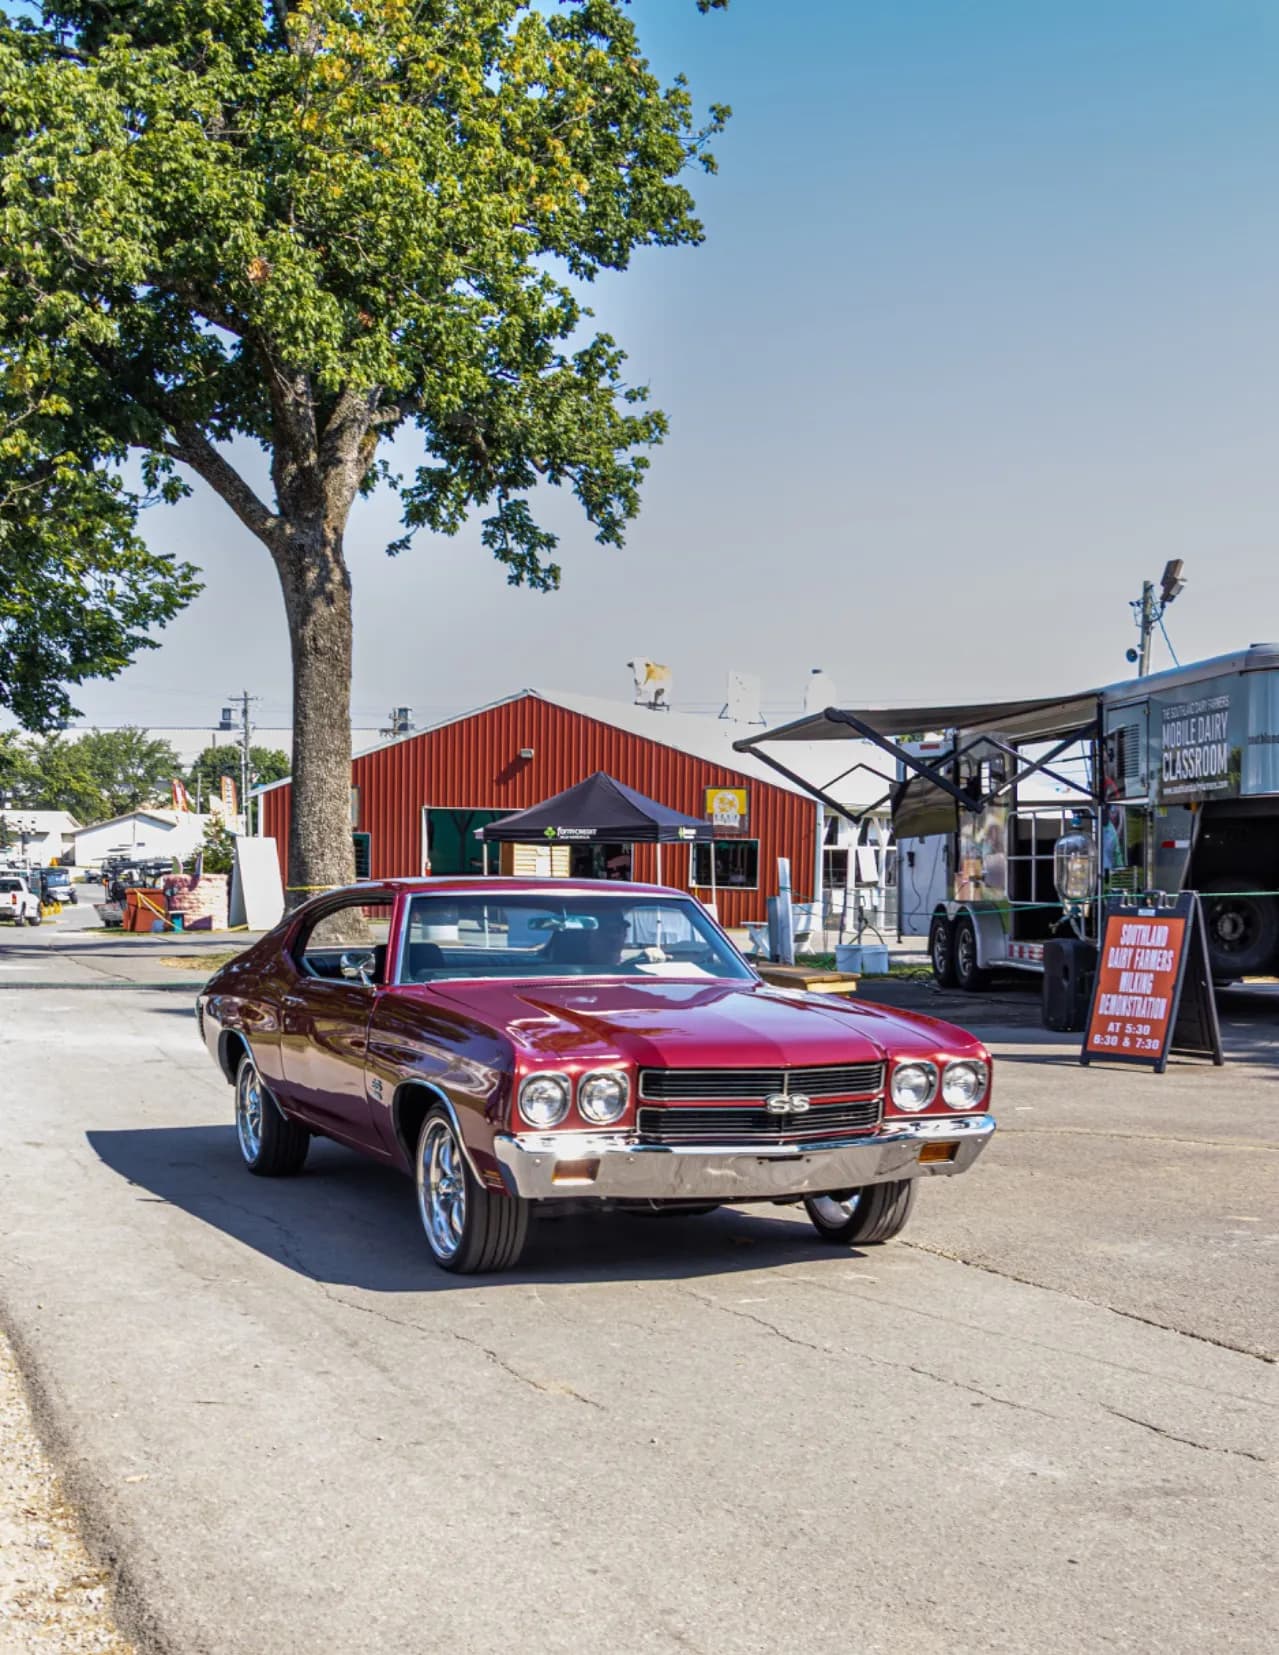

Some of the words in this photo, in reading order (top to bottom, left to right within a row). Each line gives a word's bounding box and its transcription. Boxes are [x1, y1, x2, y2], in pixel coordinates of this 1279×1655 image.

[1162, 718, 1196, 749] MOBILE
[1198, 712, 1228, 744] DAIRY
[1162, 743, 1228, 782] CLASSROOM
[1120, 923, 1169, 947] SOUTHLAND
[1107, 947, 1132, 969] DAIRY
[1133, 948, 1174, 972] FARMERS
[1119, 971, 1154, 995] MILKING
[1098, 993, 1168, 1020] DEMONSTRATION
[1107, 1022, 1122, 1033] AT
[1124, 1023, 1151, 1036] 5:30
[1093, 1034, 1119, 1047] 6:30
[1122, 1036, 1130, 1047] &
[1135, 1037, 1160, 1050] 7:30
[767, 1094, 810, 1114] SS
